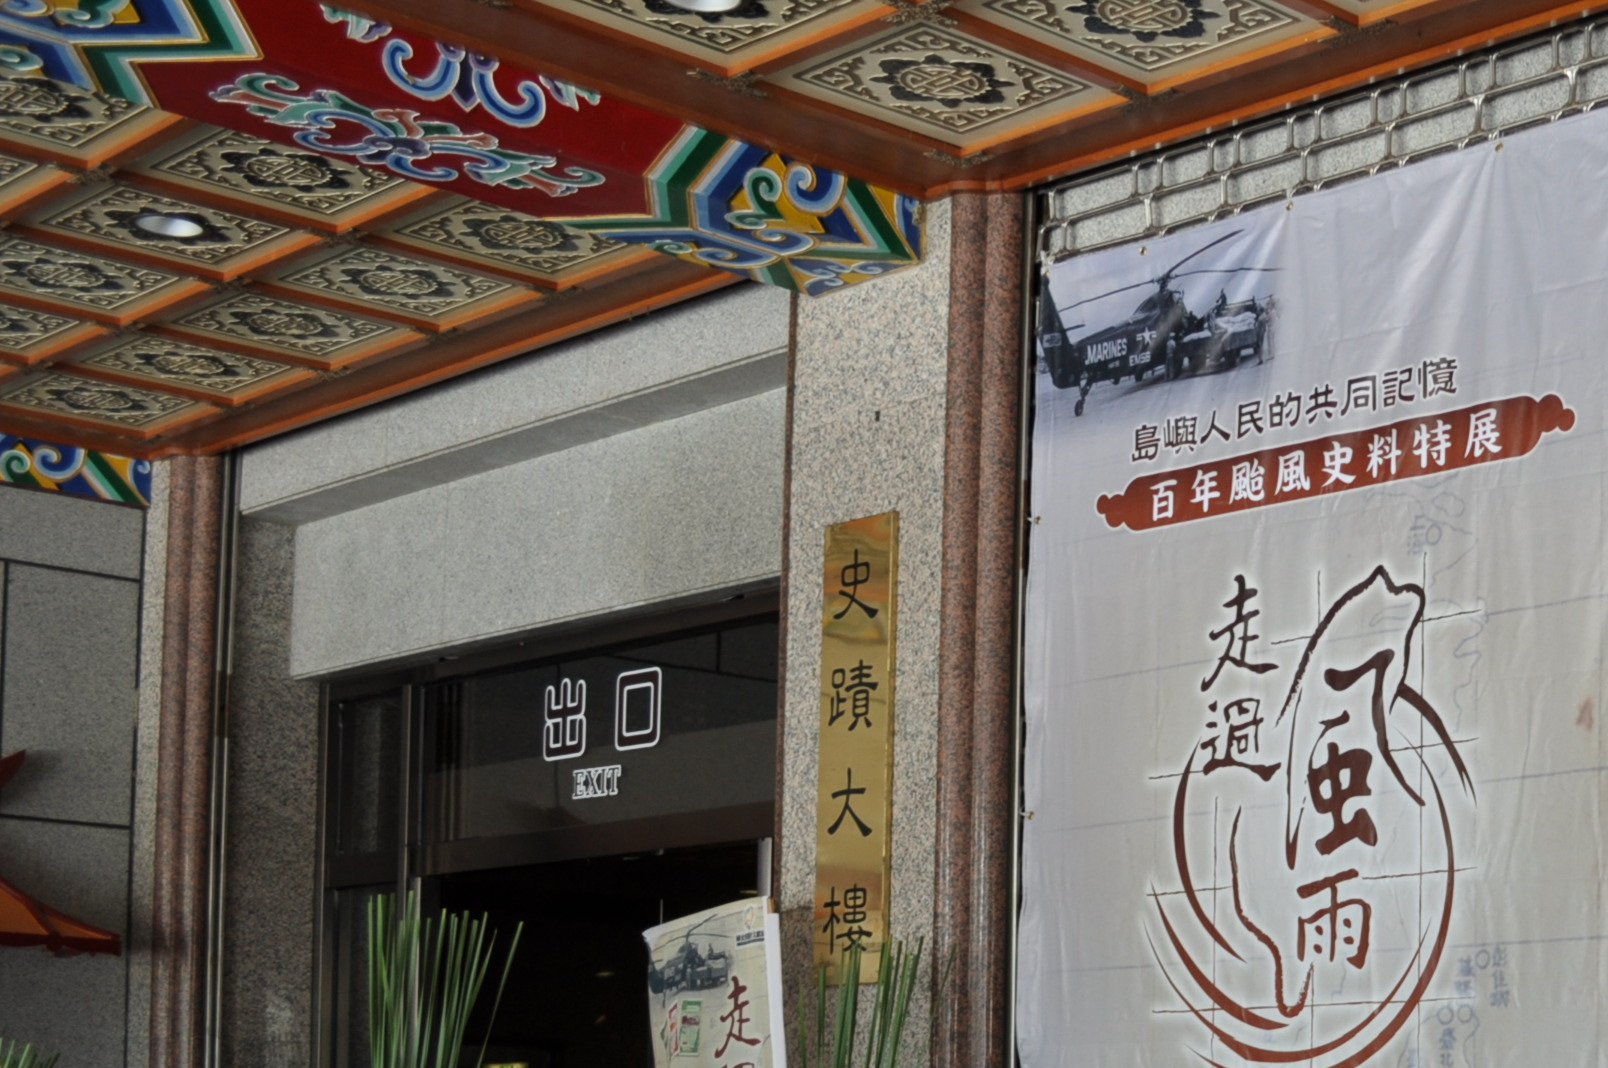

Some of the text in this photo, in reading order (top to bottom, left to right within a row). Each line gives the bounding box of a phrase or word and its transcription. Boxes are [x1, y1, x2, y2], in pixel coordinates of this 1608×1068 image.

[1085, 338, 1127, 366] MARINES
[1131, 356, 1458, 463] 島嶼人民的共同記憶
[1148, 408, 1503, 522] 百年颱風史料特展
[543, 667, 663, 762] 出口
[822, 548, 879, 955] 史蹟大樓
[572, 764, 622, 800] EXIT
